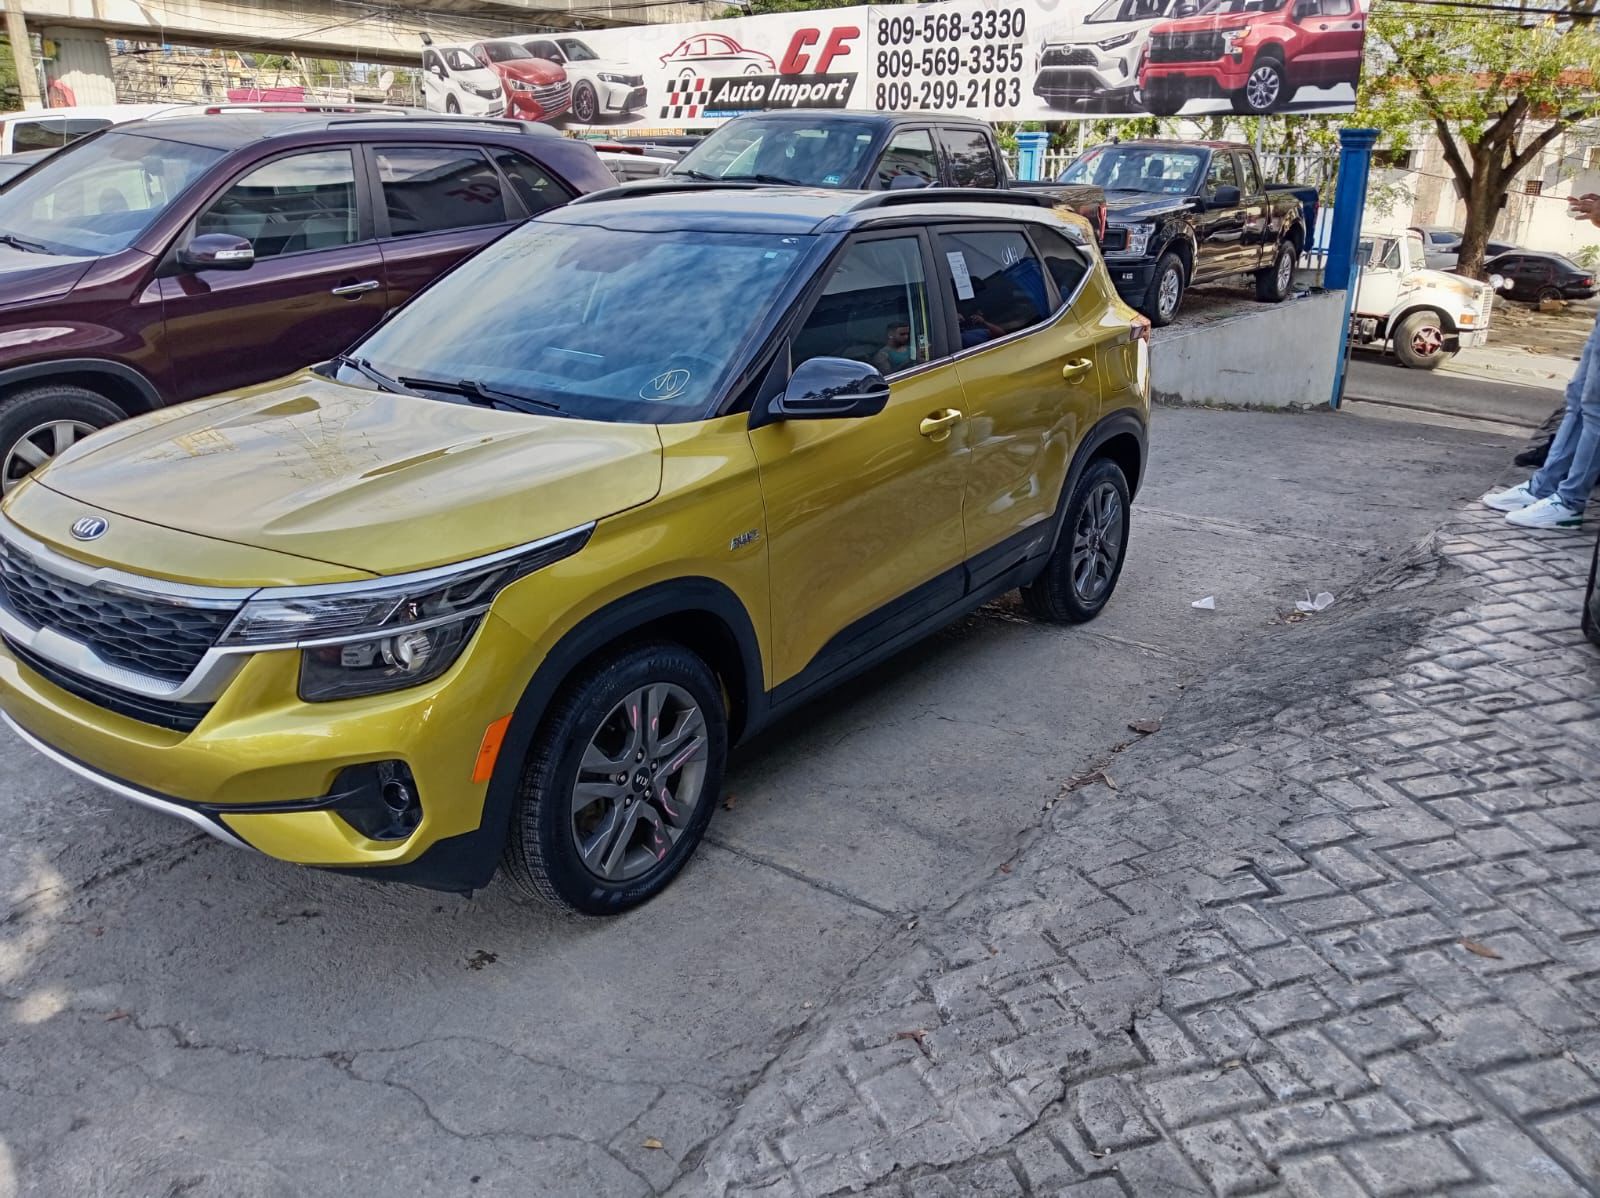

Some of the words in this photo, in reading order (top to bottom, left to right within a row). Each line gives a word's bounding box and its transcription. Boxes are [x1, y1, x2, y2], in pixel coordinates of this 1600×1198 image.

[877, 8, 1026, 46] 809-568-3330
[779, 26, 861, 75] CF
[876, 43, 1024, 78] 809-569-3355
[714, 80, 766, 104] Auto
[768, 77, 849, 108] Import
[875, 77, 1021, 111] 809-299-2183
[73, 517, 100, 536] KIA
[636, 774, 649, 786] KIA
